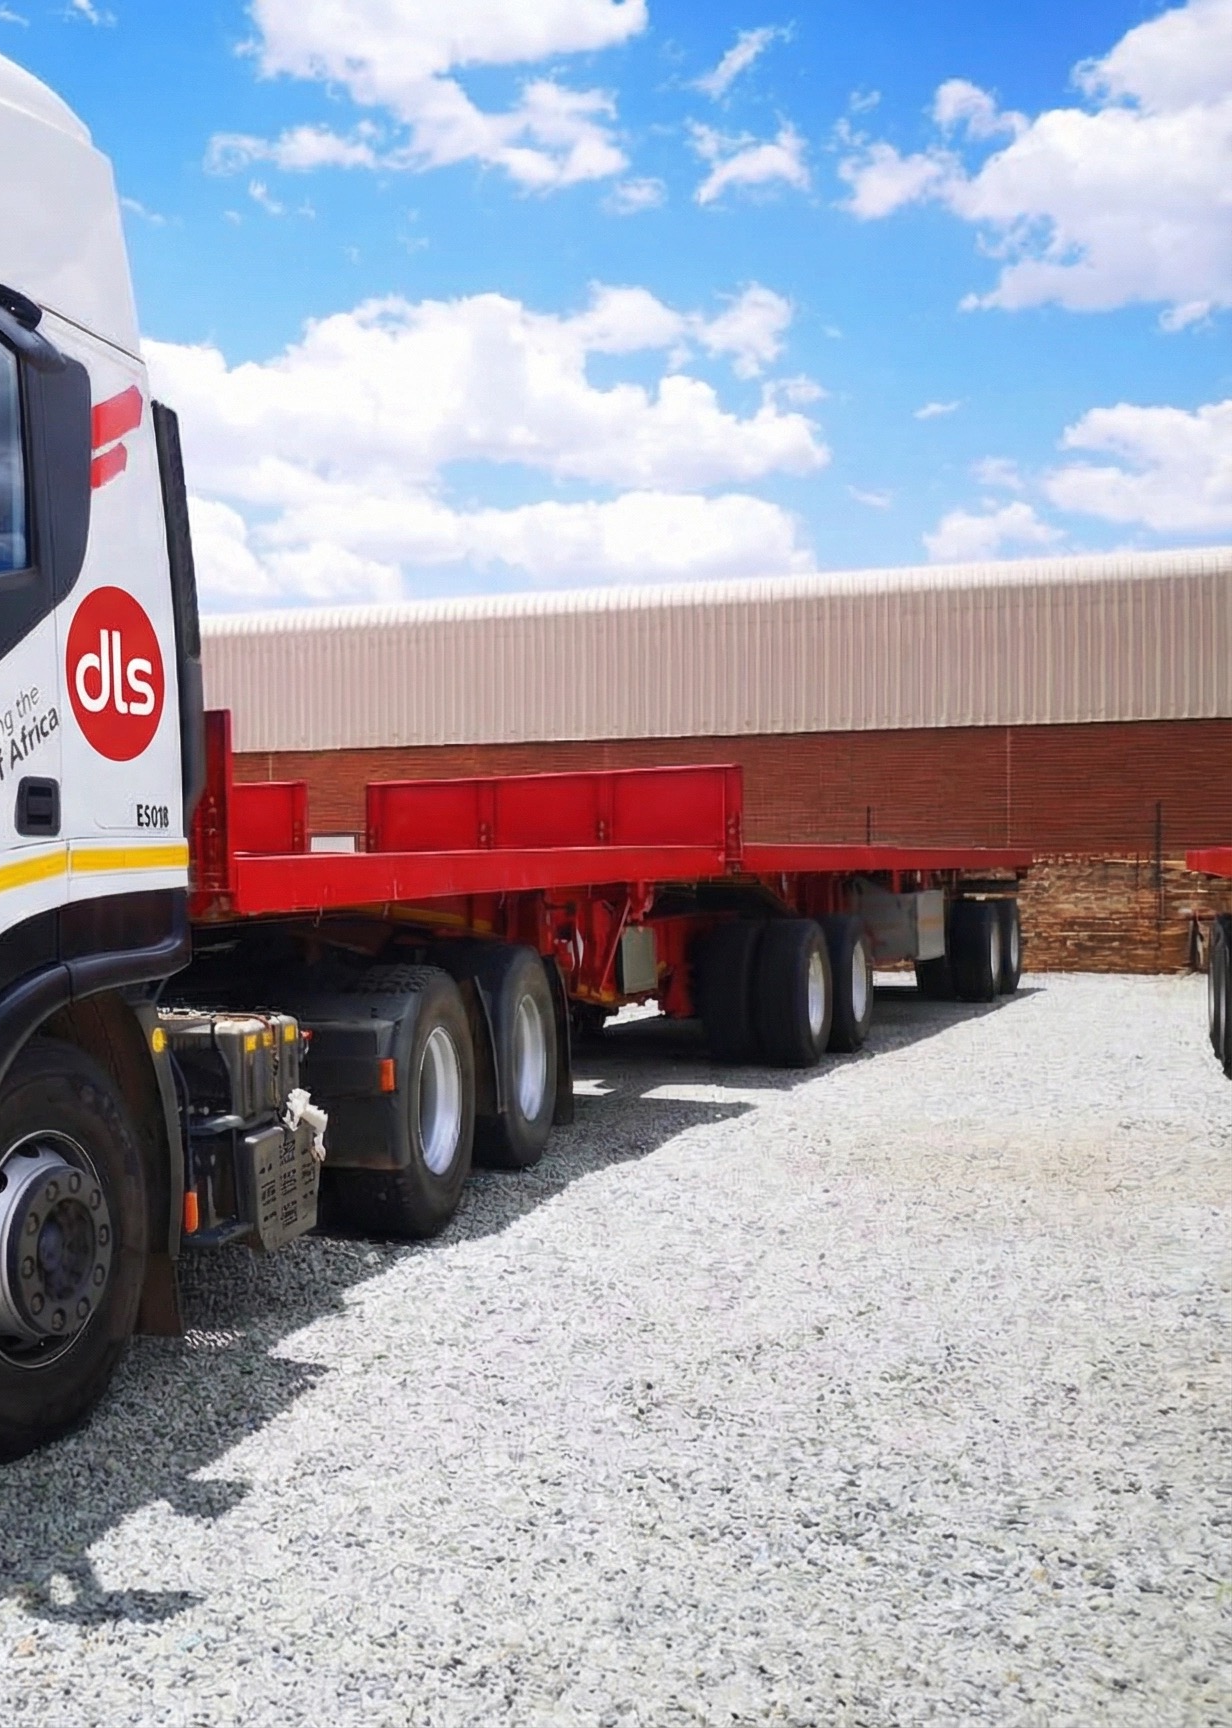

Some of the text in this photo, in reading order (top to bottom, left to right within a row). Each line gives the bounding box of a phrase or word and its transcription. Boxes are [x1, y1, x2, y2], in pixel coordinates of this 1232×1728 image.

[75, 629, 155, 716] dls
[16, 686, 40, 718] the
[10, 707, 60, 770] Africa
[136, 803, 170, 828] ES018
